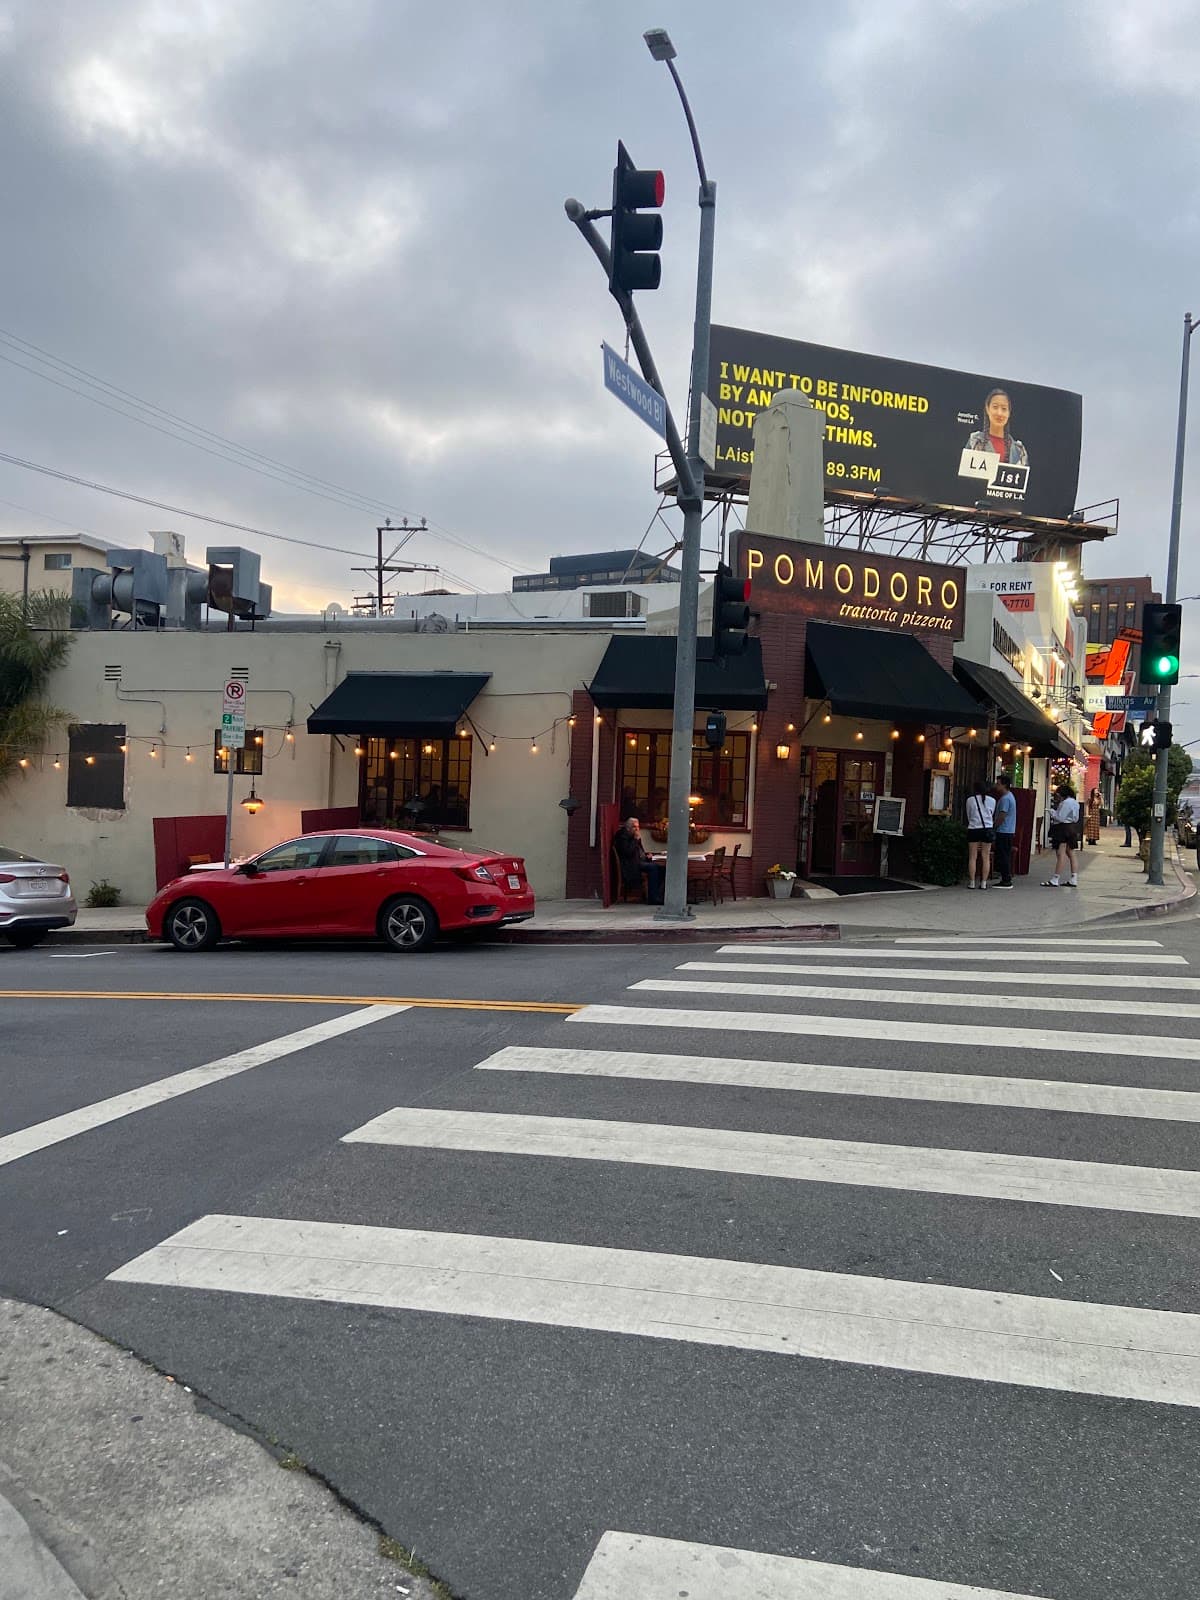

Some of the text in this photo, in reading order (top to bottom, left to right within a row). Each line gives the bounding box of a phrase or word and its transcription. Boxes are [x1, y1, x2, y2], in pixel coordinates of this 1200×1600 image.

[608, 355, 653, 416] Westwood
[720, 362, 929, 413] I WANT TO BE INFORMED
[720, 383, 743, 402] BY
[719, 407, 756, 429] NOT
[716, 445, 754, 463] LAist
[826, 461, 881, 482] 89.3FM
[969, 457, 987, 471] LA
[1001, 470, 1020, 484] ist
[986, 489, 1003, 498] MADE
[747, 549, 959, 609] POMODORO
[990, 581, 1032, 591] FOR RENT
[839, 602, 954, 630] trattoria pizzeria
[1108, 696, 1153, 706] Wilkins Av
